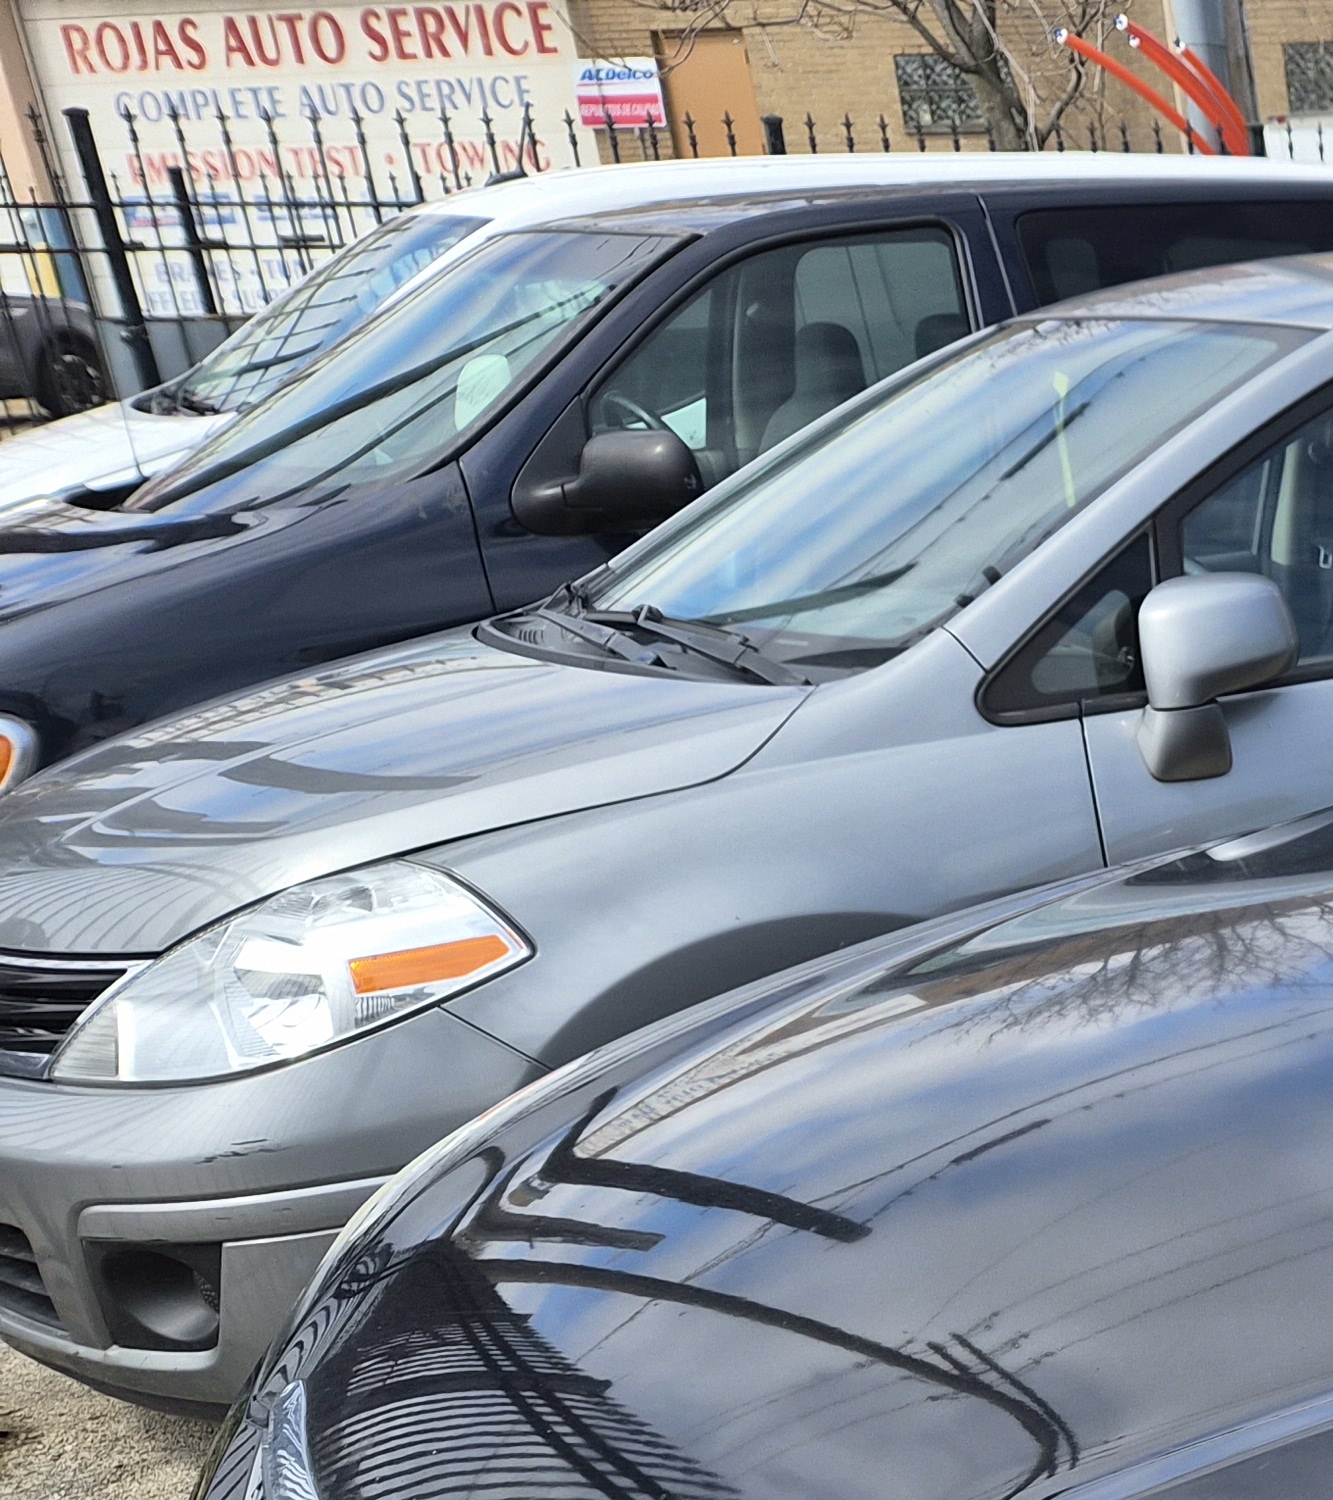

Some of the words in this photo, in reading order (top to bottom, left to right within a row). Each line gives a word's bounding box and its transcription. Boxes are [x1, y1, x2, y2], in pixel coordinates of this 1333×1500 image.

[60, 17, 207, 74] ROJAS
[223, 10, 345, 66] AUTO
[360, 1, 559, 62] SERVICE
[579, 67, 654, 81] ACDelco
[115, 85, 286, 122] COMPLETE
[299, 81, 385, 117] AUTO
[396, 75, 533, 113] SERVICE
[286, 145, 365, 182] TEST
[412, 138, 551, 175] TOWNG
